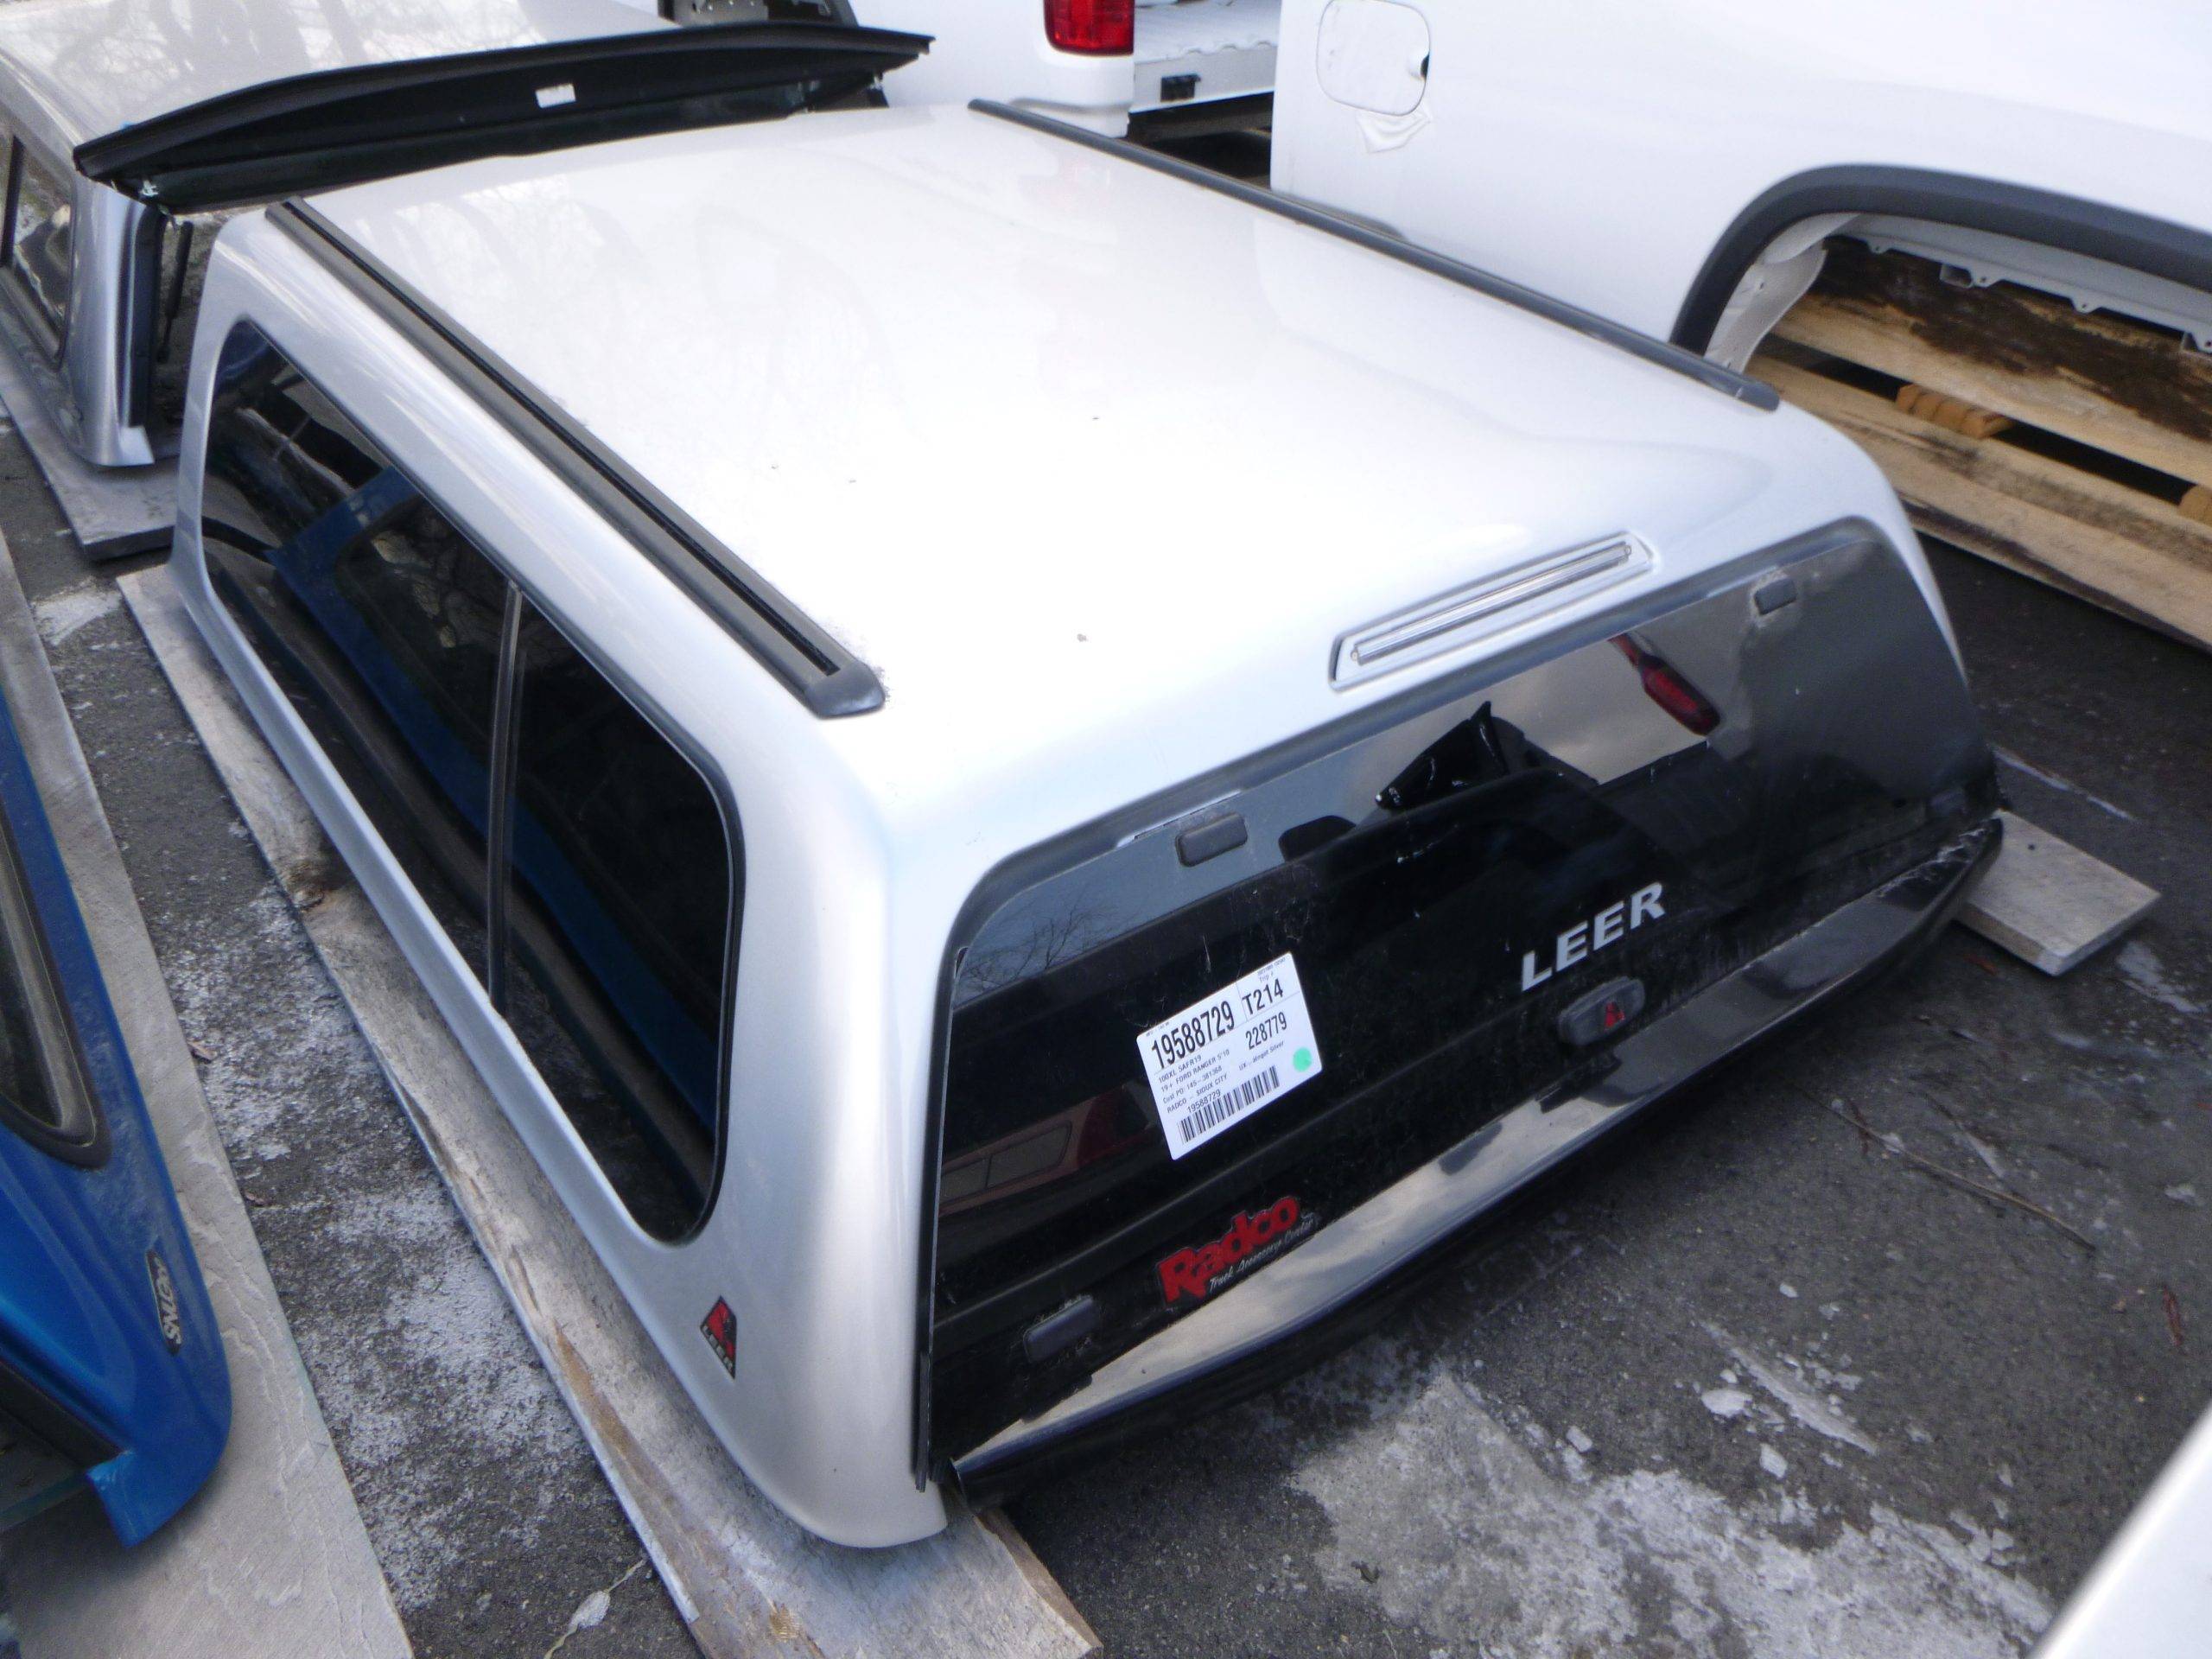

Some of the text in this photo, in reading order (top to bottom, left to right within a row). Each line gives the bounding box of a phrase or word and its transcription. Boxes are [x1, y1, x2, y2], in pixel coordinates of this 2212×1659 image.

[1522, 881, 1666, 992] LEER
[1242, 979, 1283, 1015] T214
[1152, 1001, 1235, 1069] 19588729
[1245, 1012, 1287, 1050] 228779
[1175, 1072, 1192, 1084] FORD
[1192, 1057, 1217, 1074] RANGER
[1179, 1054, 1202, 1073] SAFR19
[1167, 1098, 1187, 1113] RADCO
[1196, 1082, 1214, 1096] SIOUX
[1215, 1074, 1228, 1085] CITY
[1187, 1089, 1221, 1113] 19588729
[1157, 1195, 1300, 1304] Radco
[1209, 1268, 1234, 1294] Truck
